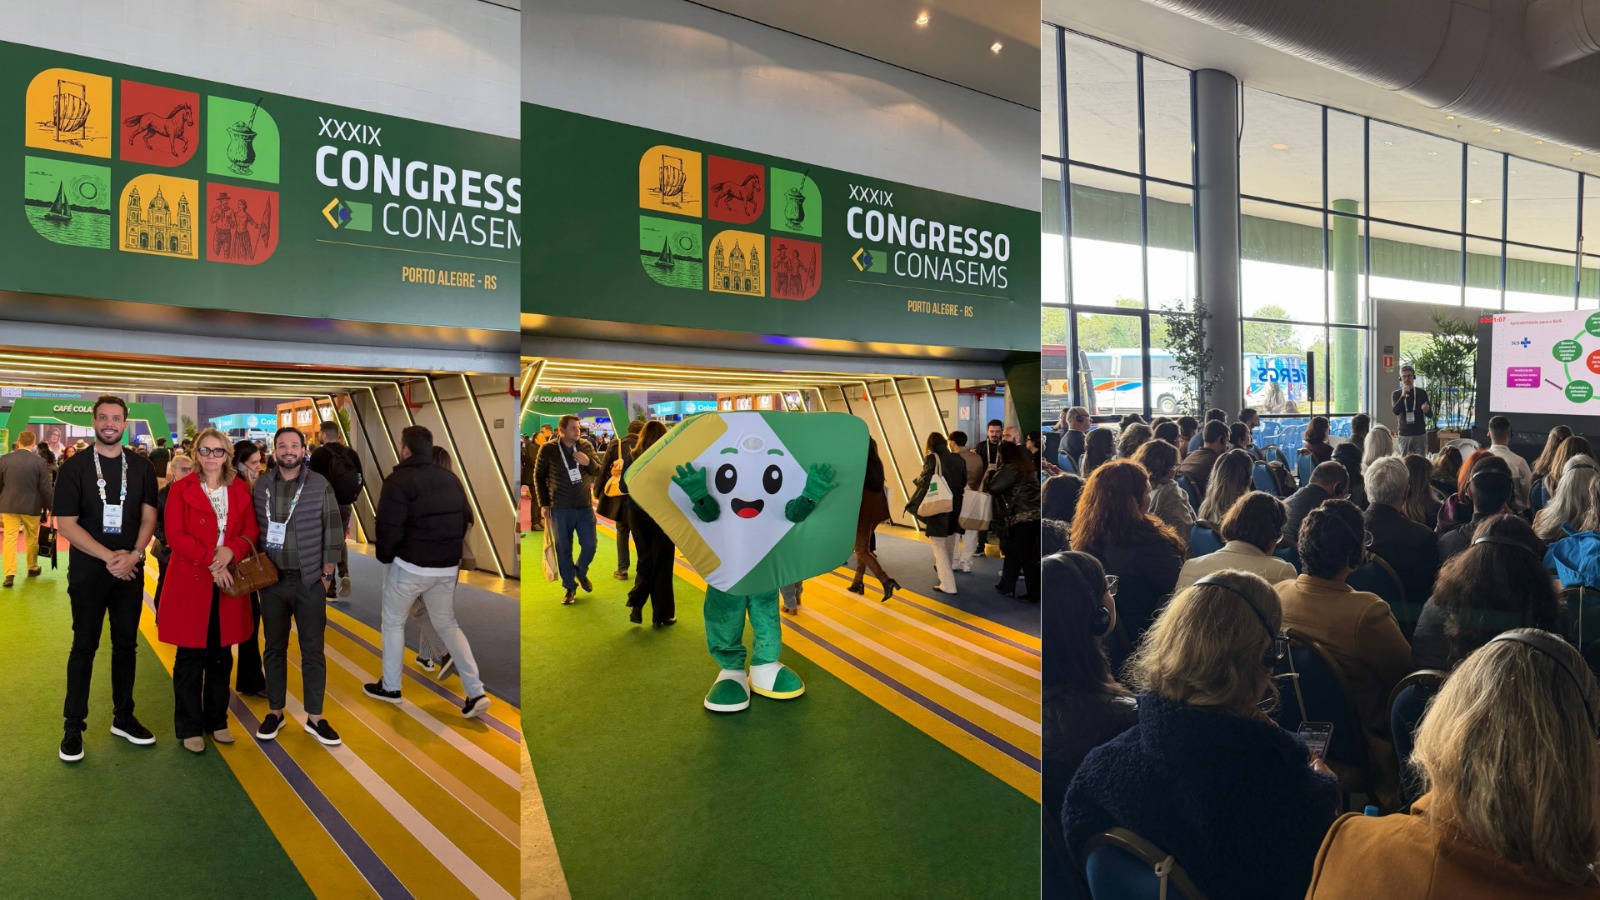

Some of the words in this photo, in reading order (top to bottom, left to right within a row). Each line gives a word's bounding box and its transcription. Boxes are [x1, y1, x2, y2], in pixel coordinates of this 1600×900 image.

[318, 116, 382, 147] XXXIX
[849, 184, 894, 208] XXXIX
[847, 206, 1010, 262] CONGRESSO
[402, 266, 435, 284] PORTO
[437, 271, 475, 288] ALEGRE
[484, 274, 497, 290] RS
[894, 250, 1008, 289] CONASEMS
[907, 299, 931, 314] PORTO
[932, 304, 959, 317] ALEGRE
[964, 306, 974, 318] RS
[53, 403, 73, 412] CAFÉ
[73, 405, 94, 413] COLA
[540, 396, 589, 404] COLABORATIVO
